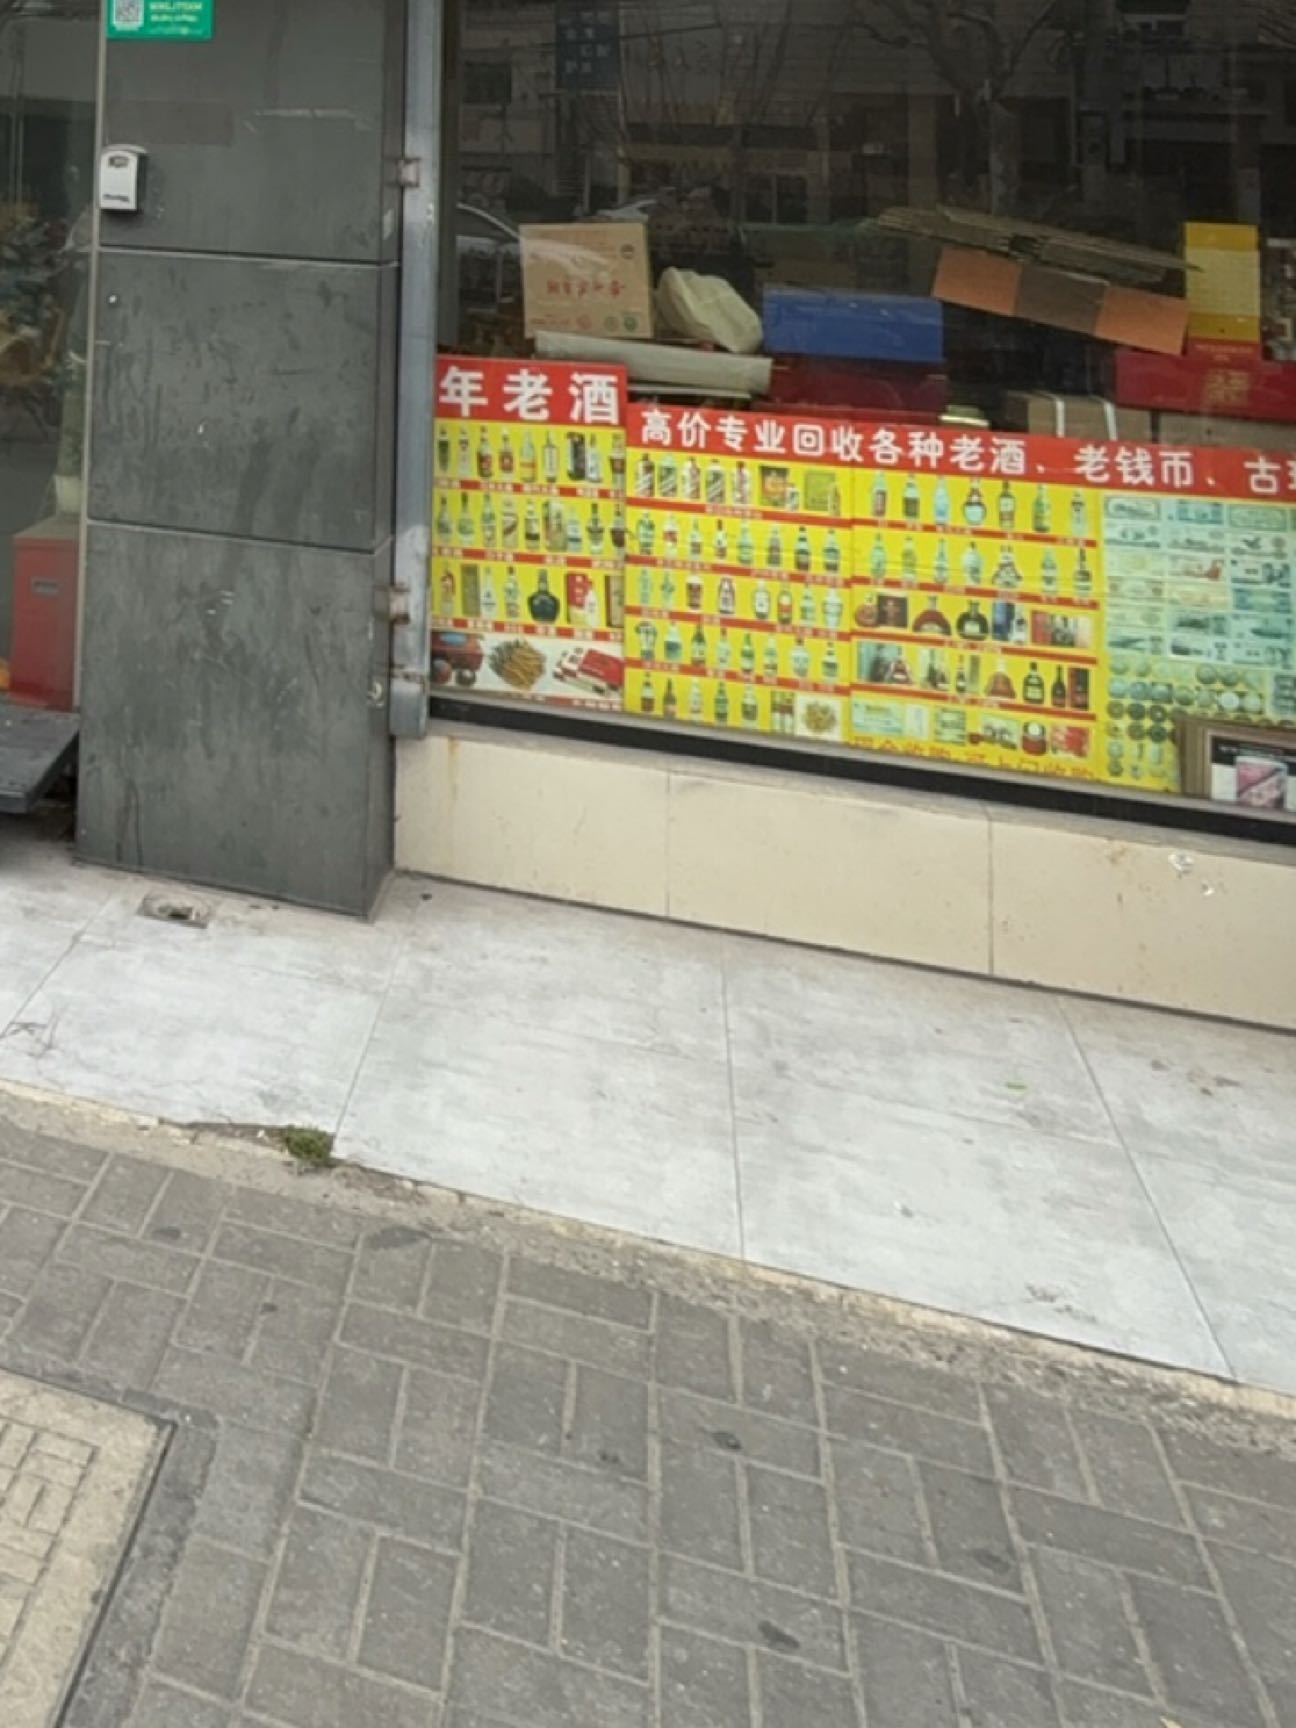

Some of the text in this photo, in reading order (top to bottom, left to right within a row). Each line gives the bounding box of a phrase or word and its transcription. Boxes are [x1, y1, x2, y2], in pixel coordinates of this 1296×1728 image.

[438, 365, 620, 426] 年老酒
[641, 408, 1296, 495] 高价专业回收各种老酒、老钱币、古
